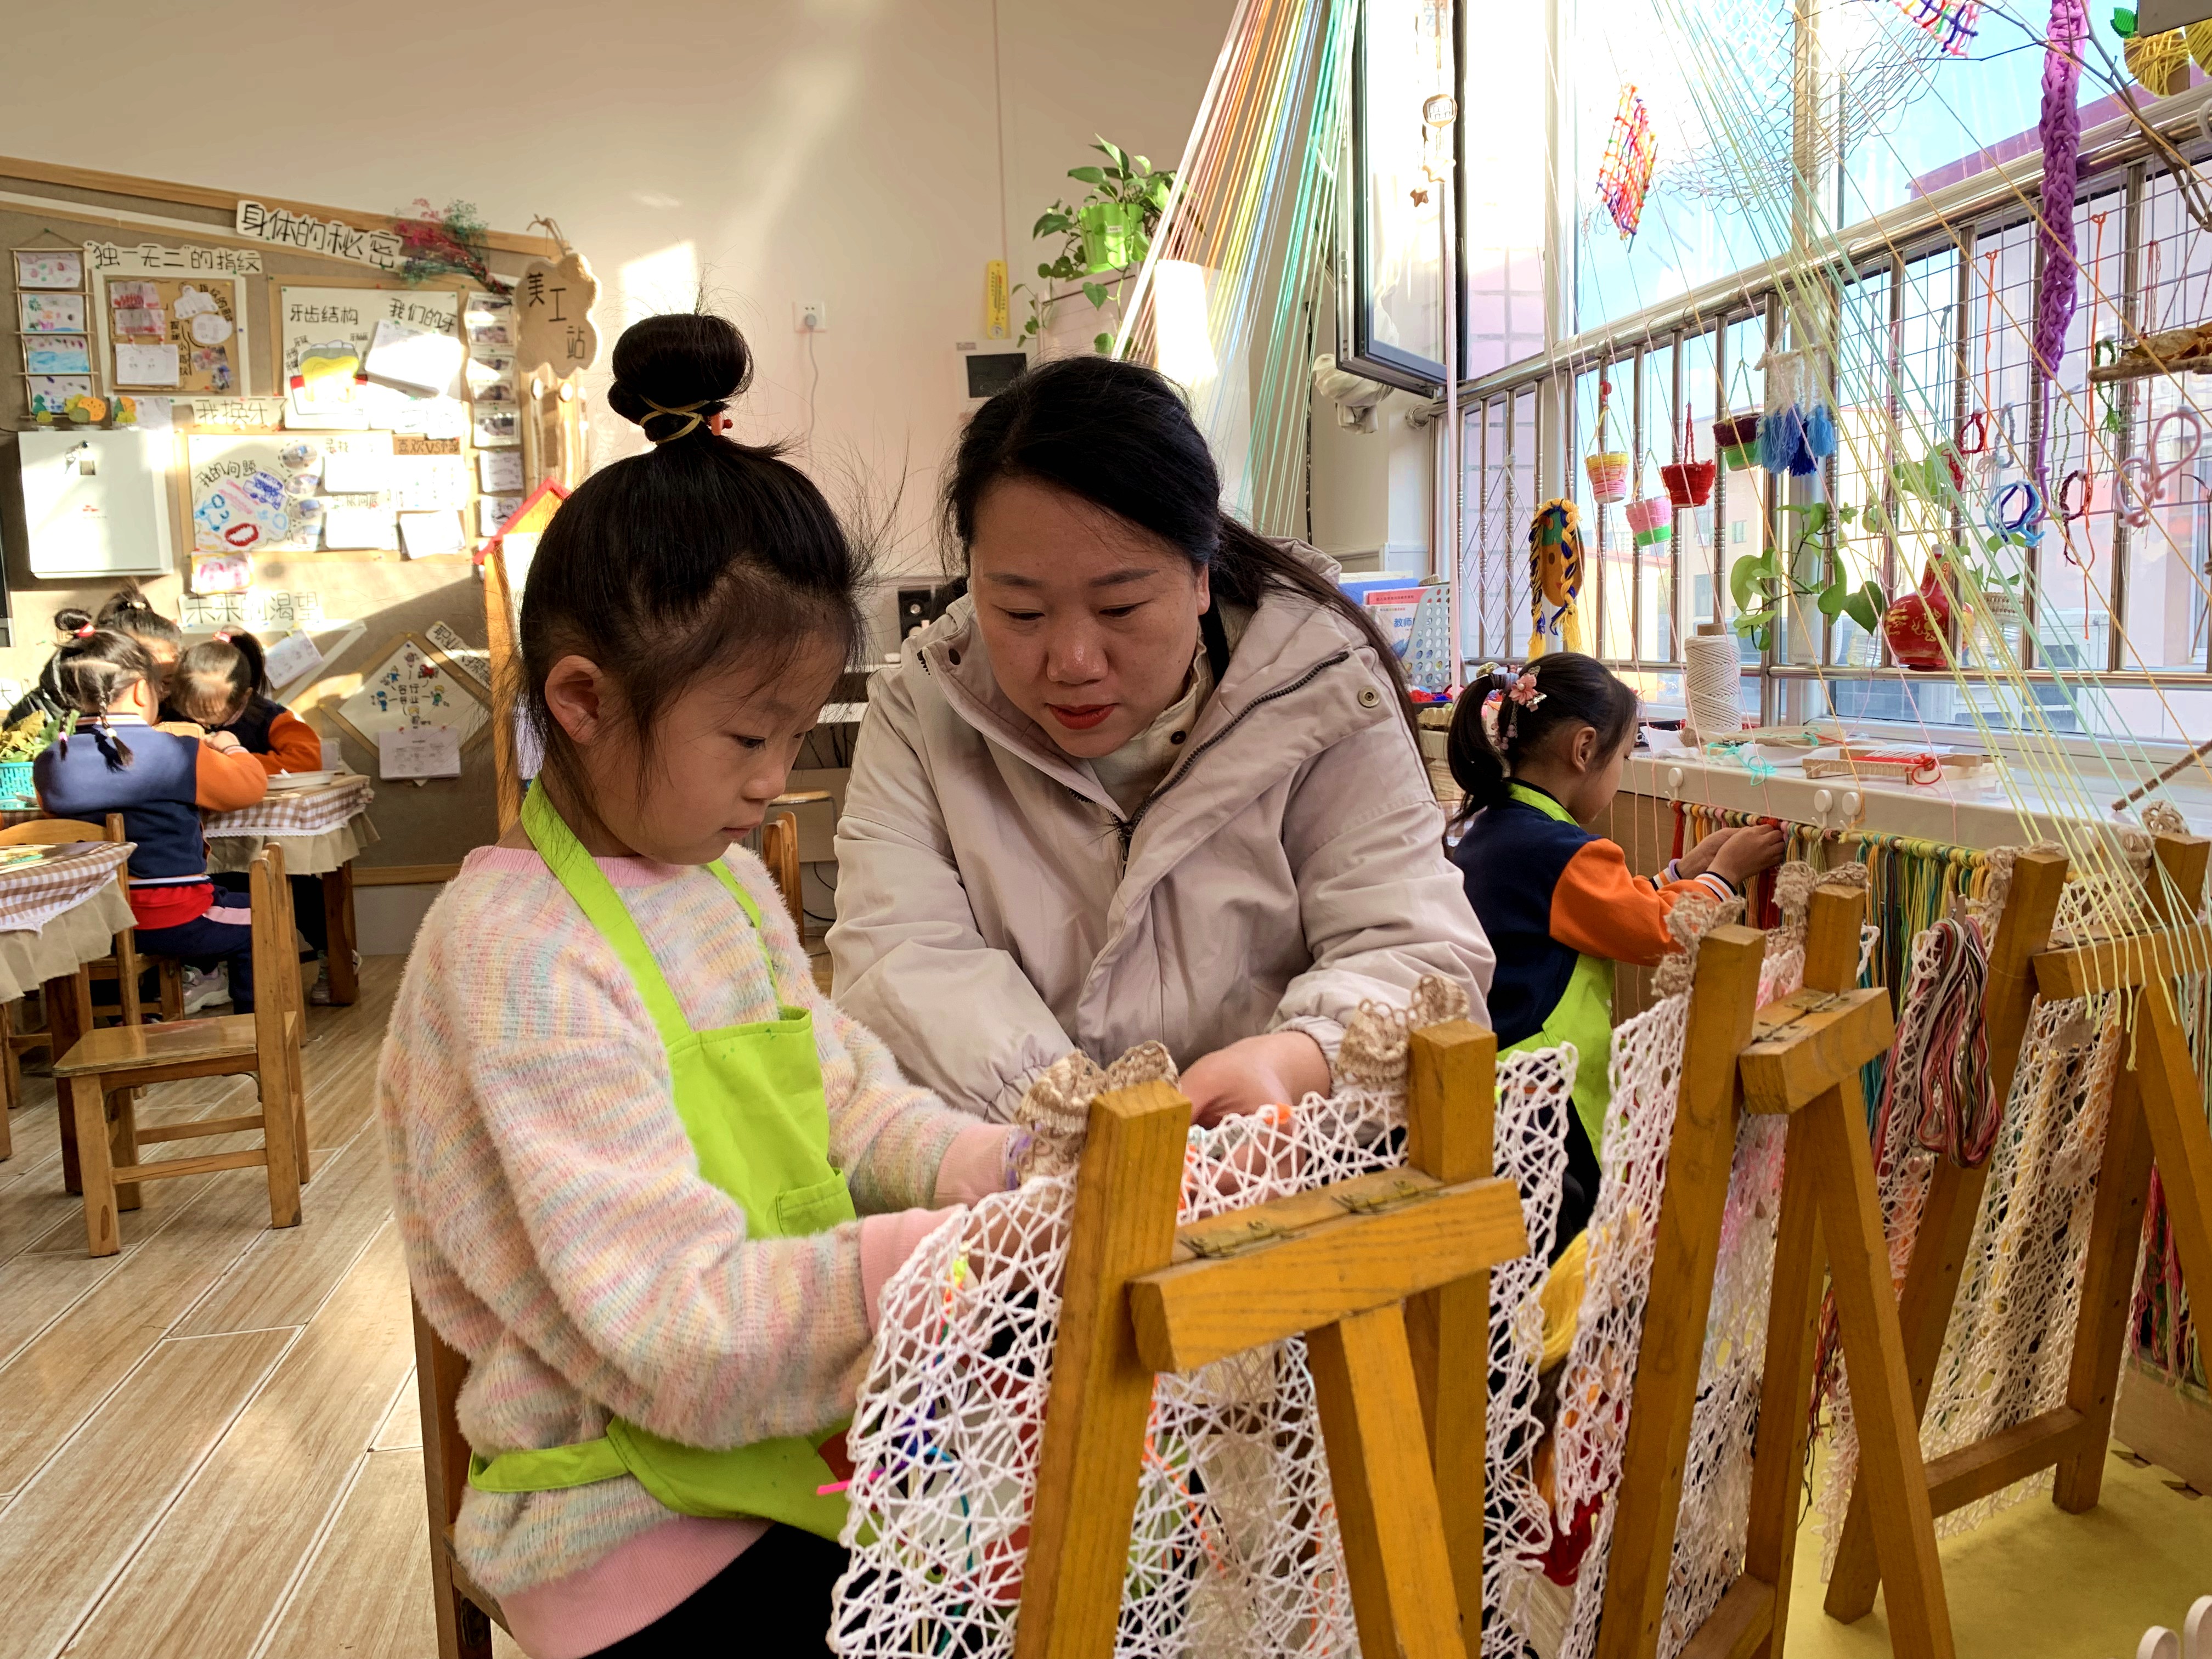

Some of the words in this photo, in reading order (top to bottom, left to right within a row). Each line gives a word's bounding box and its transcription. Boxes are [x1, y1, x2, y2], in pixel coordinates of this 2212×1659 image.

[241, 204, 400, 268] 身体的秘密
[290, 304, 358, 325] 牙齿结构
[390, 298, 458, 332] 我们的牙
[527, 272, 586, 359] 美工站
[195, 459, 258, 488] 我的问题
[186, 591, 319, 623] 未来的渴望
[1393, 617, 1415, 628] 教师
